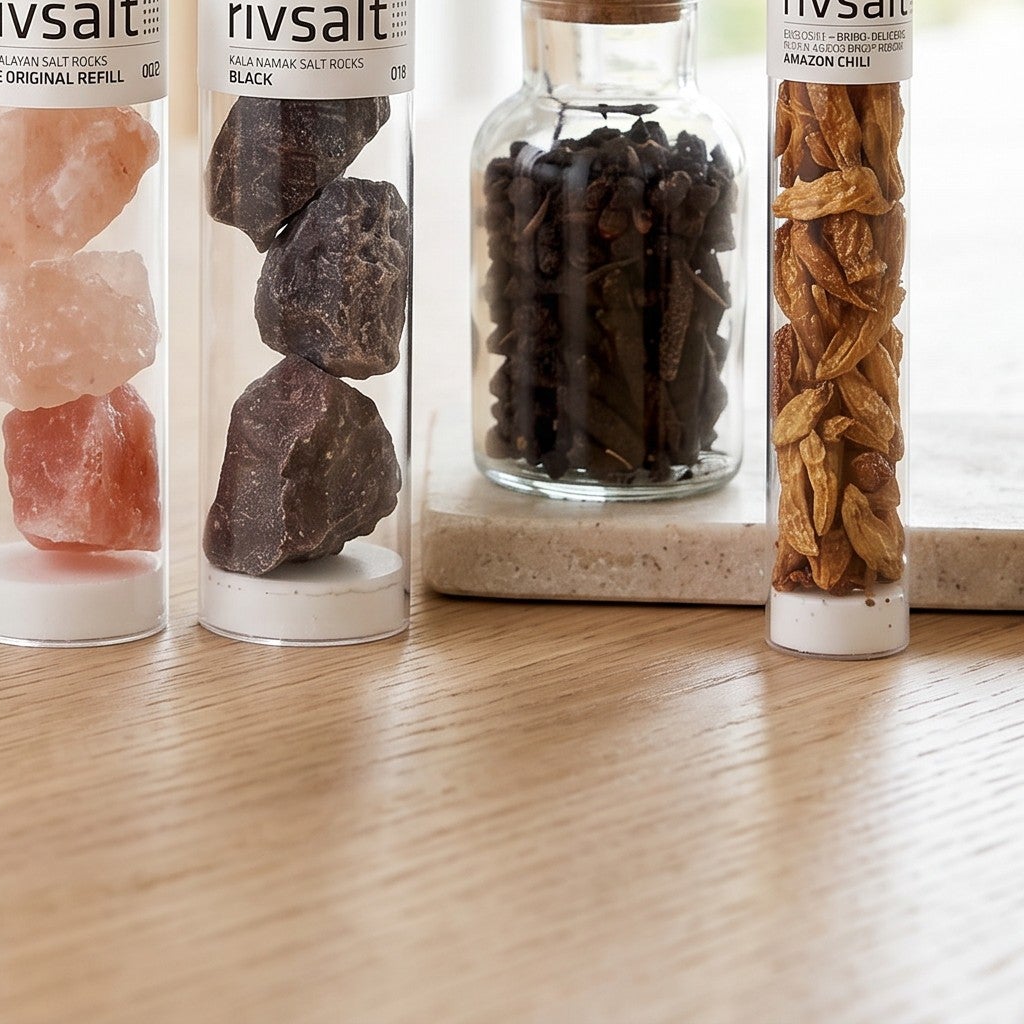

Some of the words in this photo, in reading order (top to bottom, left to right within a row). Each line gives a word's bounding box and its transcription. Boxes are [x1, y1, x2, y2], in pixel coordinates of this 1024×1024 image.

[42, 56, 69, 67] SALT
[72, 55, 108, 67] ROCKS
[229, 55, 254, 67] KALA
[256, 57, 297, 69] NAMAK
[299, 58, 327, 70] SALT
[329, 57, 364, 69] ROCKS
[783, 53, 834, 67] AMAZON
[837, 56, 870, 68] CHILI
[6, 70, 74, 85] ORIGINAL
[78, 69, 124, 85] REFILL
[229, 70, 273, 86] BLACK
[390, 64, 407, 81] 018
